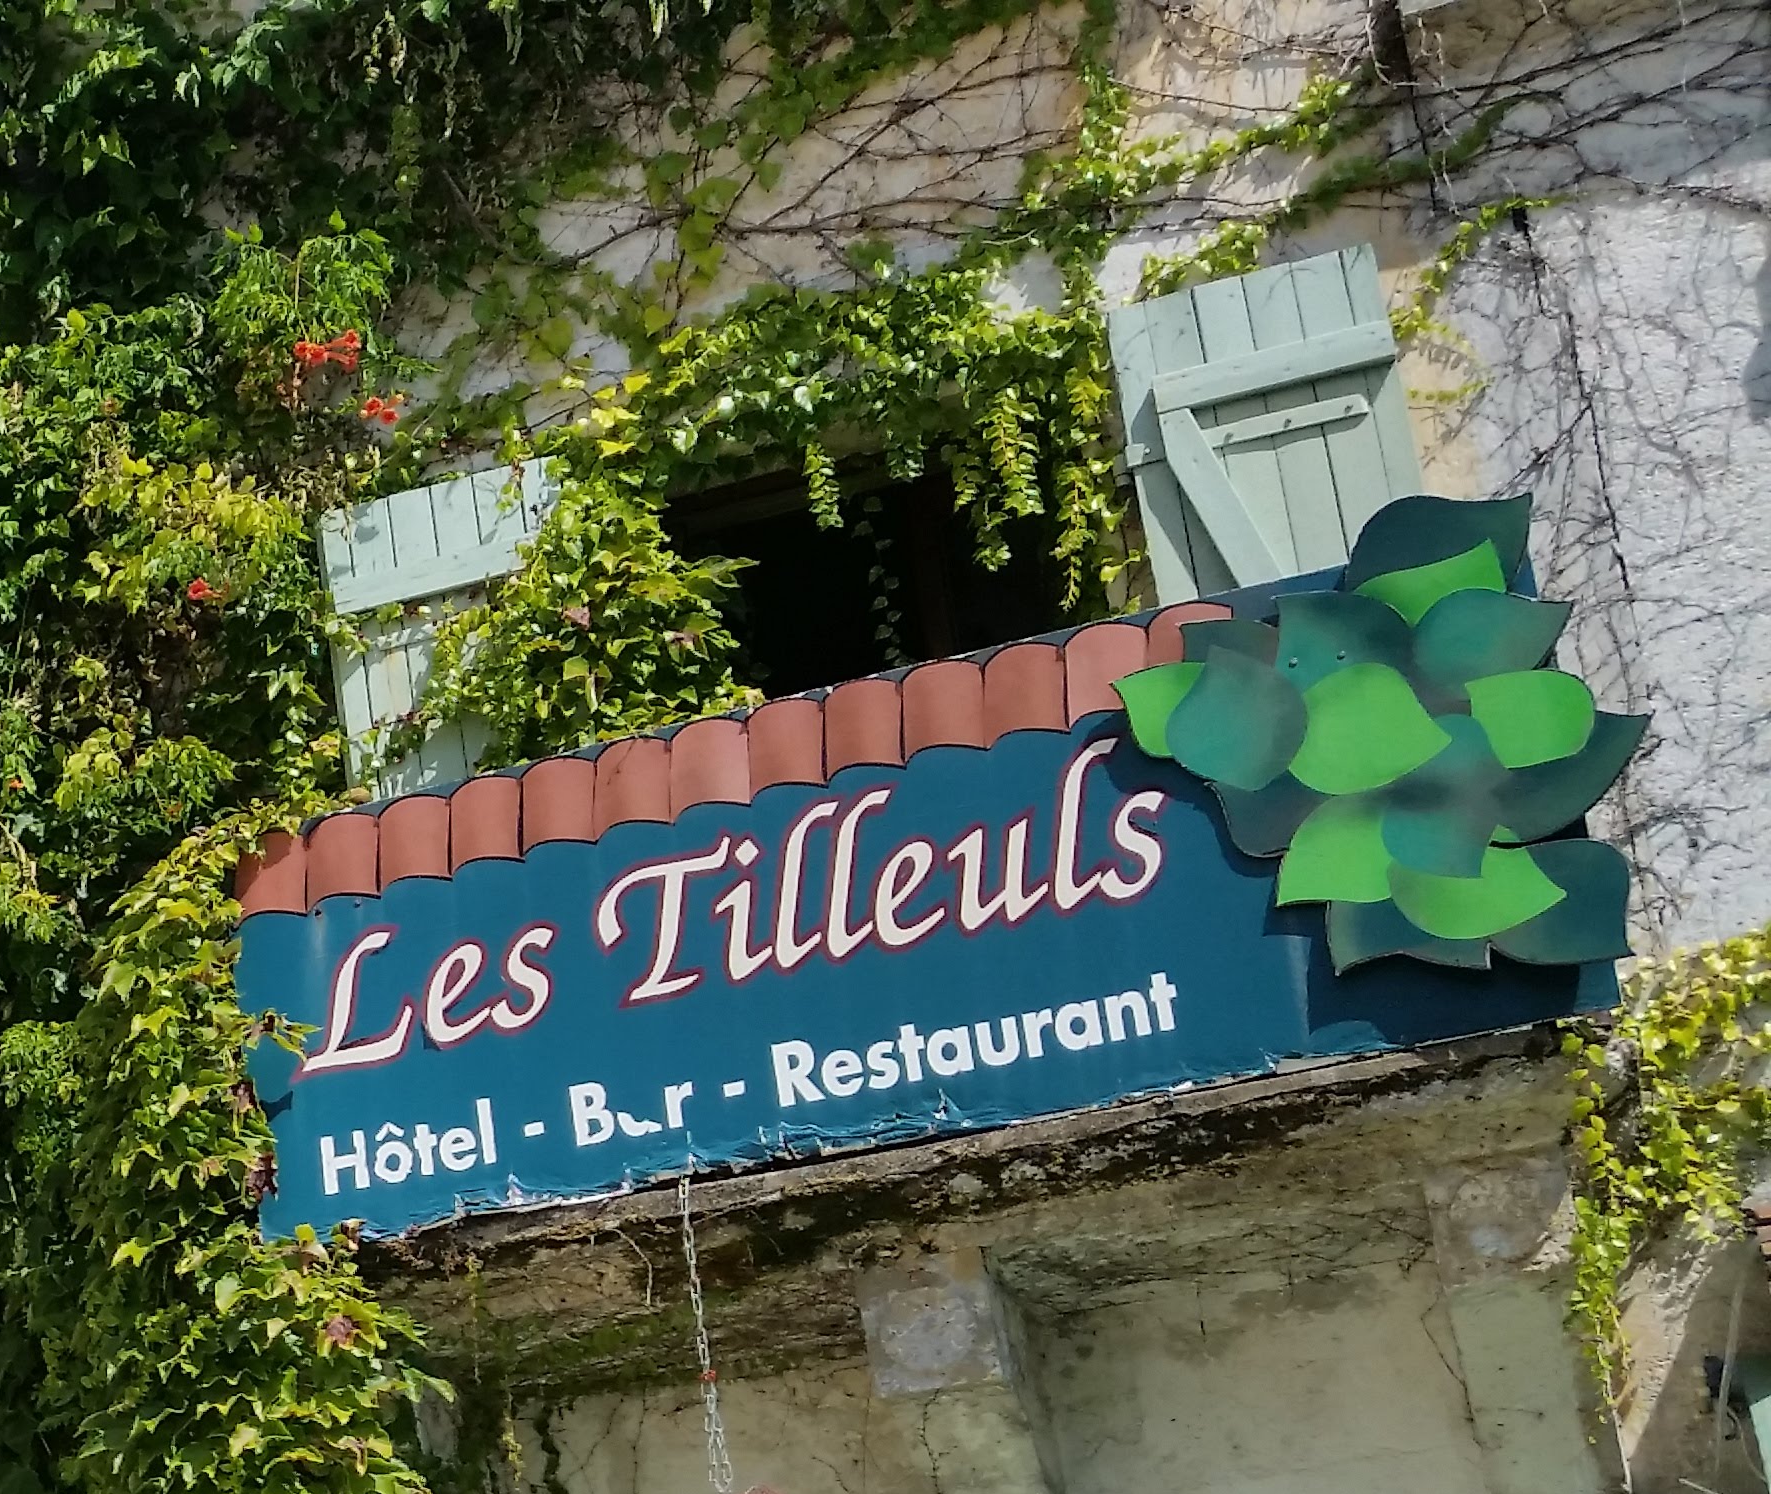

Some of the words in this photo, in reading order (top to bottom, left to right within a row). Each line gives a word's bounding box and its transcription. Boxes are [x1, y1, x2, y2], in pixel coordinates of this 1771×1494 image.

[301, 928, 556, 1073] Les
[596, 736, 1167, 1003] Tilleuls
[319, 1096, 499, 1196] Hôtel
[769, 970, 1179, 1109] Restaurant
